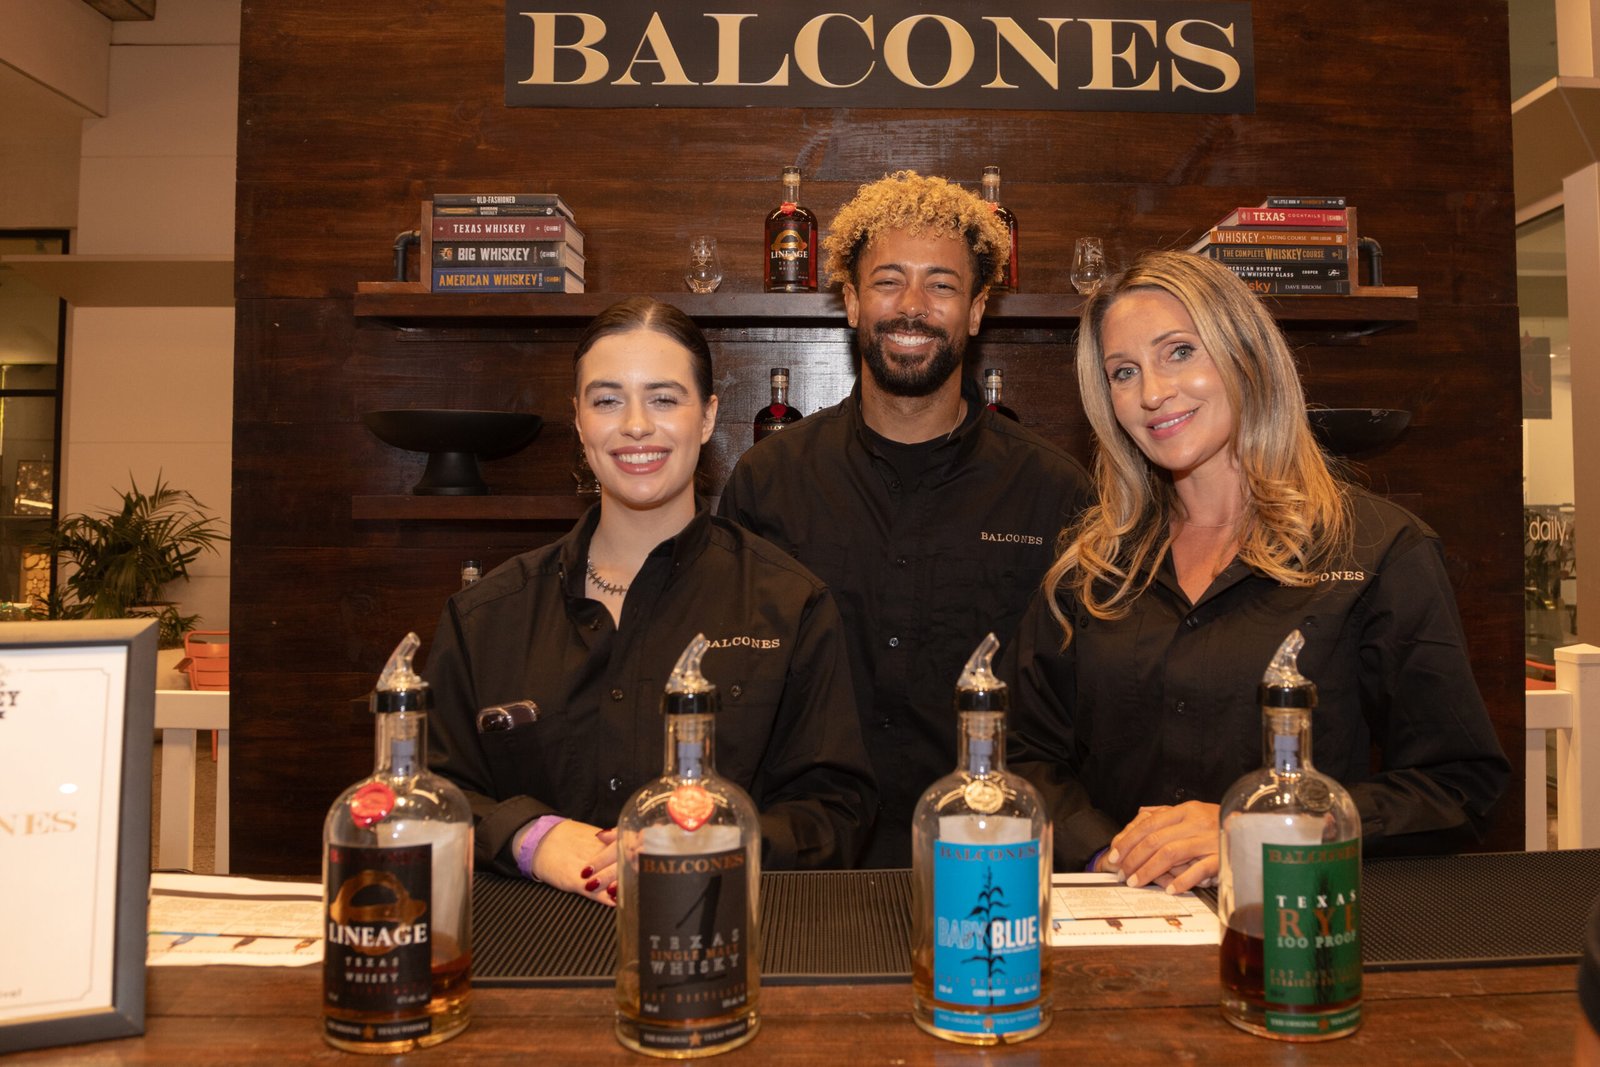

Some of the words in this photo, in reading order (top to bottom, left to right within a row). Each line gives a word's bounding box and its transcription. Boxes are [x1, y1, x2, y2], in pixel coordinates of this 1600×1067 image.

[517, 11, 1241, 94] BALCONES
[476, 196, 516, 204] OLD-FASHIONED
[1253, 212, 1286, 221] TEXAS
[453, 224, 482, 233] TEXAS
[485, 224, 526, 233] WHISKEY
[1217, 232, 1259, 243] WHISKEY
[458, 248, 476, 261] BIG
[480, 248, 530, 261] WHISKEY
[771, 250, 808, 259] LINEAGE
[1264, 248, 1302, 260] WHISKEY
[439, 274, 489, 287] AMERICAN
[494, 274, 537, 286] WHISKEY
[980, 532, 1043, 545] BALCONES
[643, 854, 746, 874] BALCONES
[1276, 889, 1356, 908] TEXAS
[329, 922, 428, 947] LINEAGE
[650, 928, 739, 950] TEXAS
[938, 916, 986, 950] BABY
[991, 916, 1037, 949] BLUE
[1277, 936, 1309, 948] 100
[1315, 930, 1356, 948] PROOF
[345, 956, 399, 968] TEXAS
[650, 954, 739, 976] WHISKY
[345, 972, 399, 984] WHISKY
